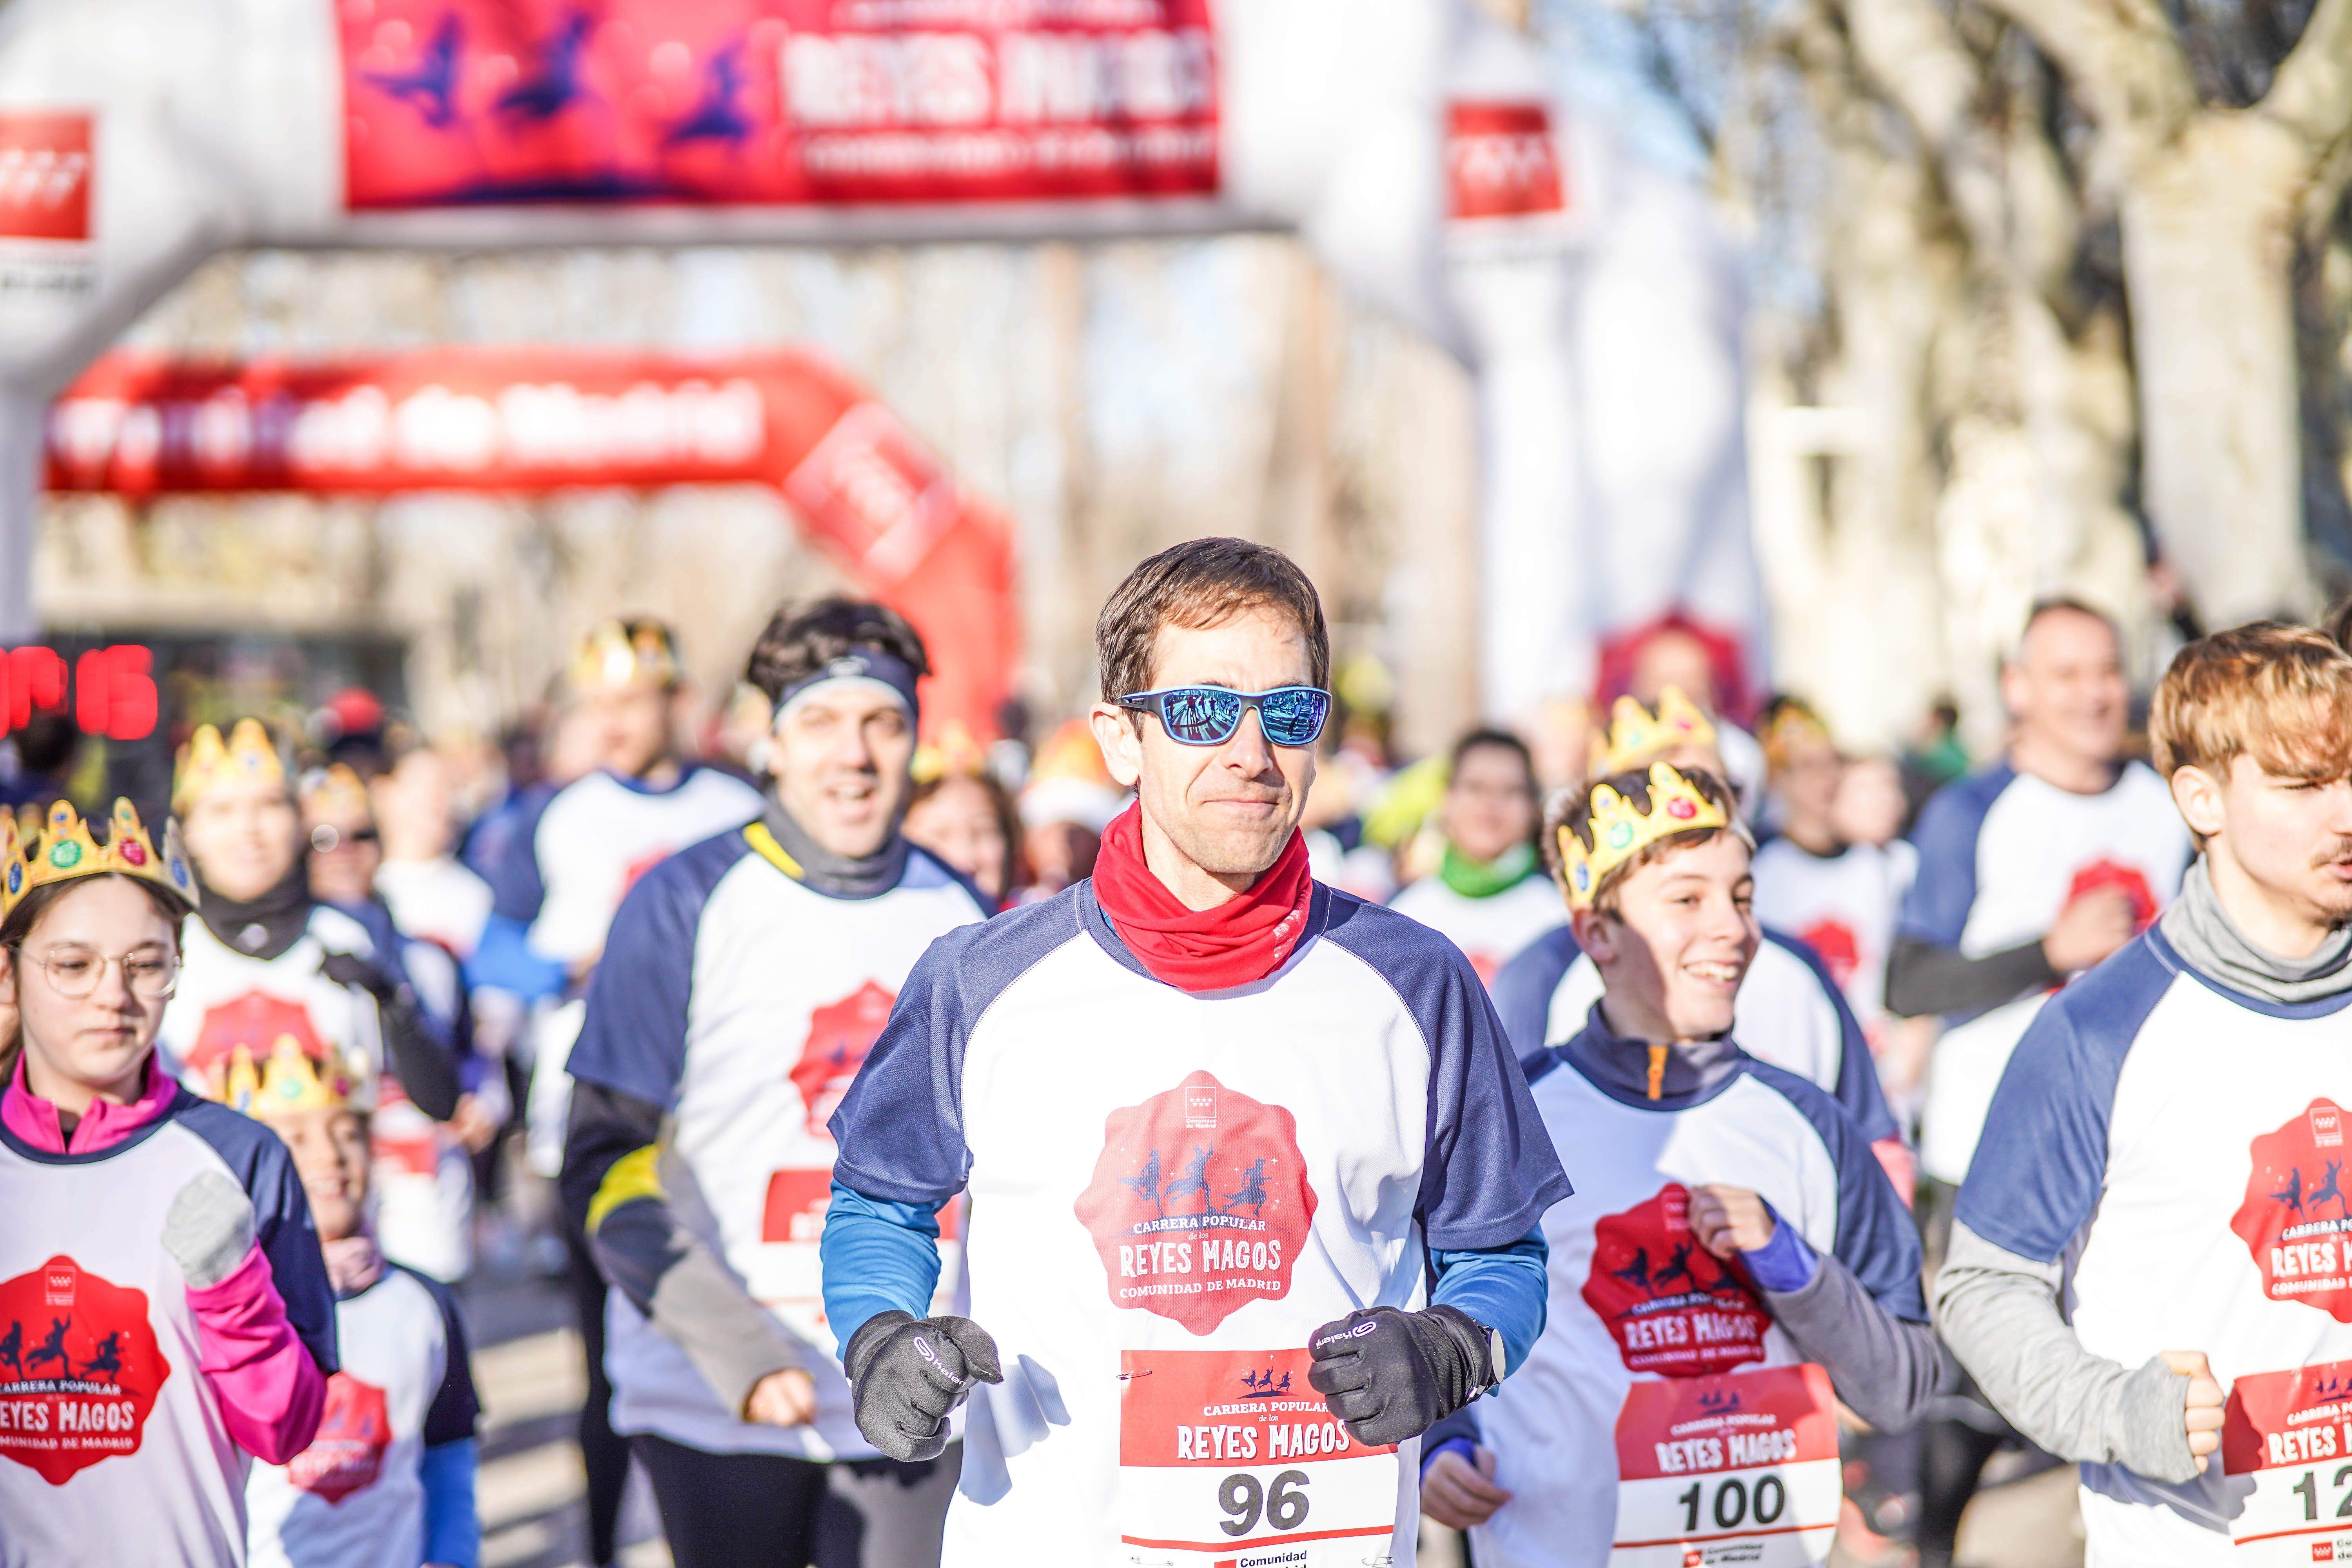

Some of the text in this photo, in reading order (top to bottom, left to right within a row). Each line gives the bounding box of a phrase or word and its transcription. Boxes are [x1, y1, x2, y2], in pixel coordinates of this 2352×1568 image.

[1134, 1216, 1266, 1234] CARRERA POPULAR
[2282, 1220, 2339, 1241] CARRERA
[1119, 1240, 1281, 1278] REYES MAGOS
[2271, 1243, 2337, 1278] REYES
[1120, 1278, 1281, 1298] COMUNIDAD DE MADRID
[2272, 1277, 2347, 1296] COMUNIDAD
[1624, 1316, 1688, 1351] REYES
[0, 1380, 121, 1395] ARRERA POPULAR
[59, 1401, 135, 1433] MAGOS
[1203, 1401, 1329, 1416] CARRERA POPULAR
[2287, 1404, 2340, 1426] CARRERA
[62, 1437, 79, 1449] DE
[81, 1437, 134, 1449] MADRID
[1177, 1419, 1350, 1461] REYES MAGOS
[1655, 1428, 1797, 1474] REYES MAGOS
[2267, 1425, 2337, 1464] REYES
[1218, 1470, 1310, 1536] 96
[1679, 1475, 1784, 1532] 100
[1240, 1550, 1307, 1568] Comunidad
